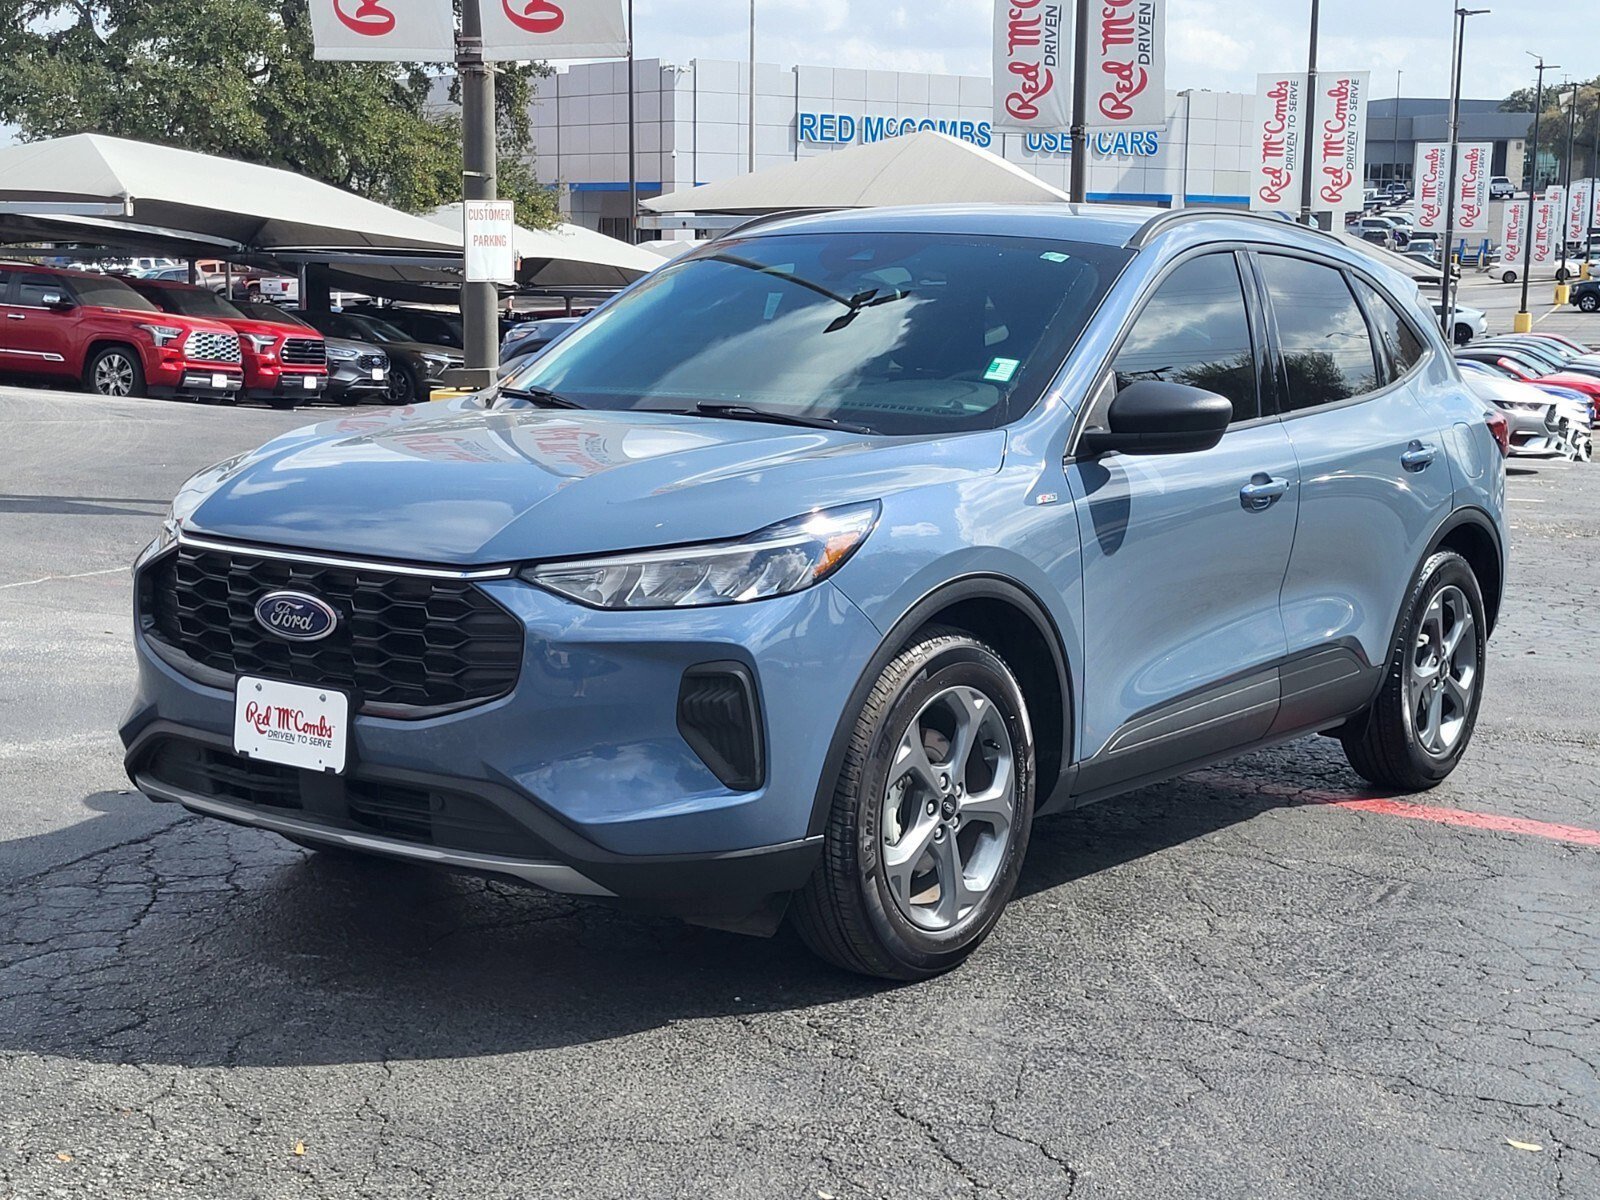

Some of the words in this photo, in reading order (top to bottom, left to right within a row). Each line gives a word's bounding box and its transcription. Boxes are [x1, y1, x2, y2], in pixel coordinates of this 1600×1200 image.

[1044, 5, 1059, 67] DRIVEN
[1138, 3, 1152, 66] DRIVEN
[1005, 61, 1053, 120] Red
[1099, 60, 1148, 120] Red
[1289, 80, 1299, 112] SERVE
[1349, 79, 1360, 111] SERVE
[800, 113, 855, 142] RED
[1262, 80, 1289, 164] McCombs
[1288, 114, 1297, 129] TO
[1323, 79, 1350, 163] McCombs
[1348, 114, 1357, 128] TO
[1028, 133, 1090, 152] USE
[1097, 131, 1158, 156] CARS
[1286, 132, 1296, 171] DRIVEN
[1346, 131, 1356, 170] DRIVEN
[1259, 166, 1291, 203] Red
[1320, 166, 1352, 203] Red
[1422, 148, 1439, 202] McCombs
[1439, 170, 1445, 181] TO
[1462, 148, 1479, 202] McCombs
[1478, 170, 1485, 181] TO
[1437, 181, 1445, 206] DRIVEN
[1477, 181, 1485, 207] DRIVEN
[468, 208, 511, 221] CUSTOMER
[1419, 203, 1441, 227] Red
[1459, 203, 1481, 227] Red
[1506, 204, 1520, 243] McCombs
[1535, 204, 1549, 243] McCombs
[473, 234, 507, 247] PARKING
[1504, 244, 1521, 262] Red
[1533, 244, 1550, 262] Red
[270, 600, 314, 631] Ford
[245, 700, 271, 735] Red
[274, 705, 333, 739] McCombs
[267, 729, 296, 742] DRIVEN
[297, 734, 308, 744] TO
[308, 736, 332, 749] SERVE
